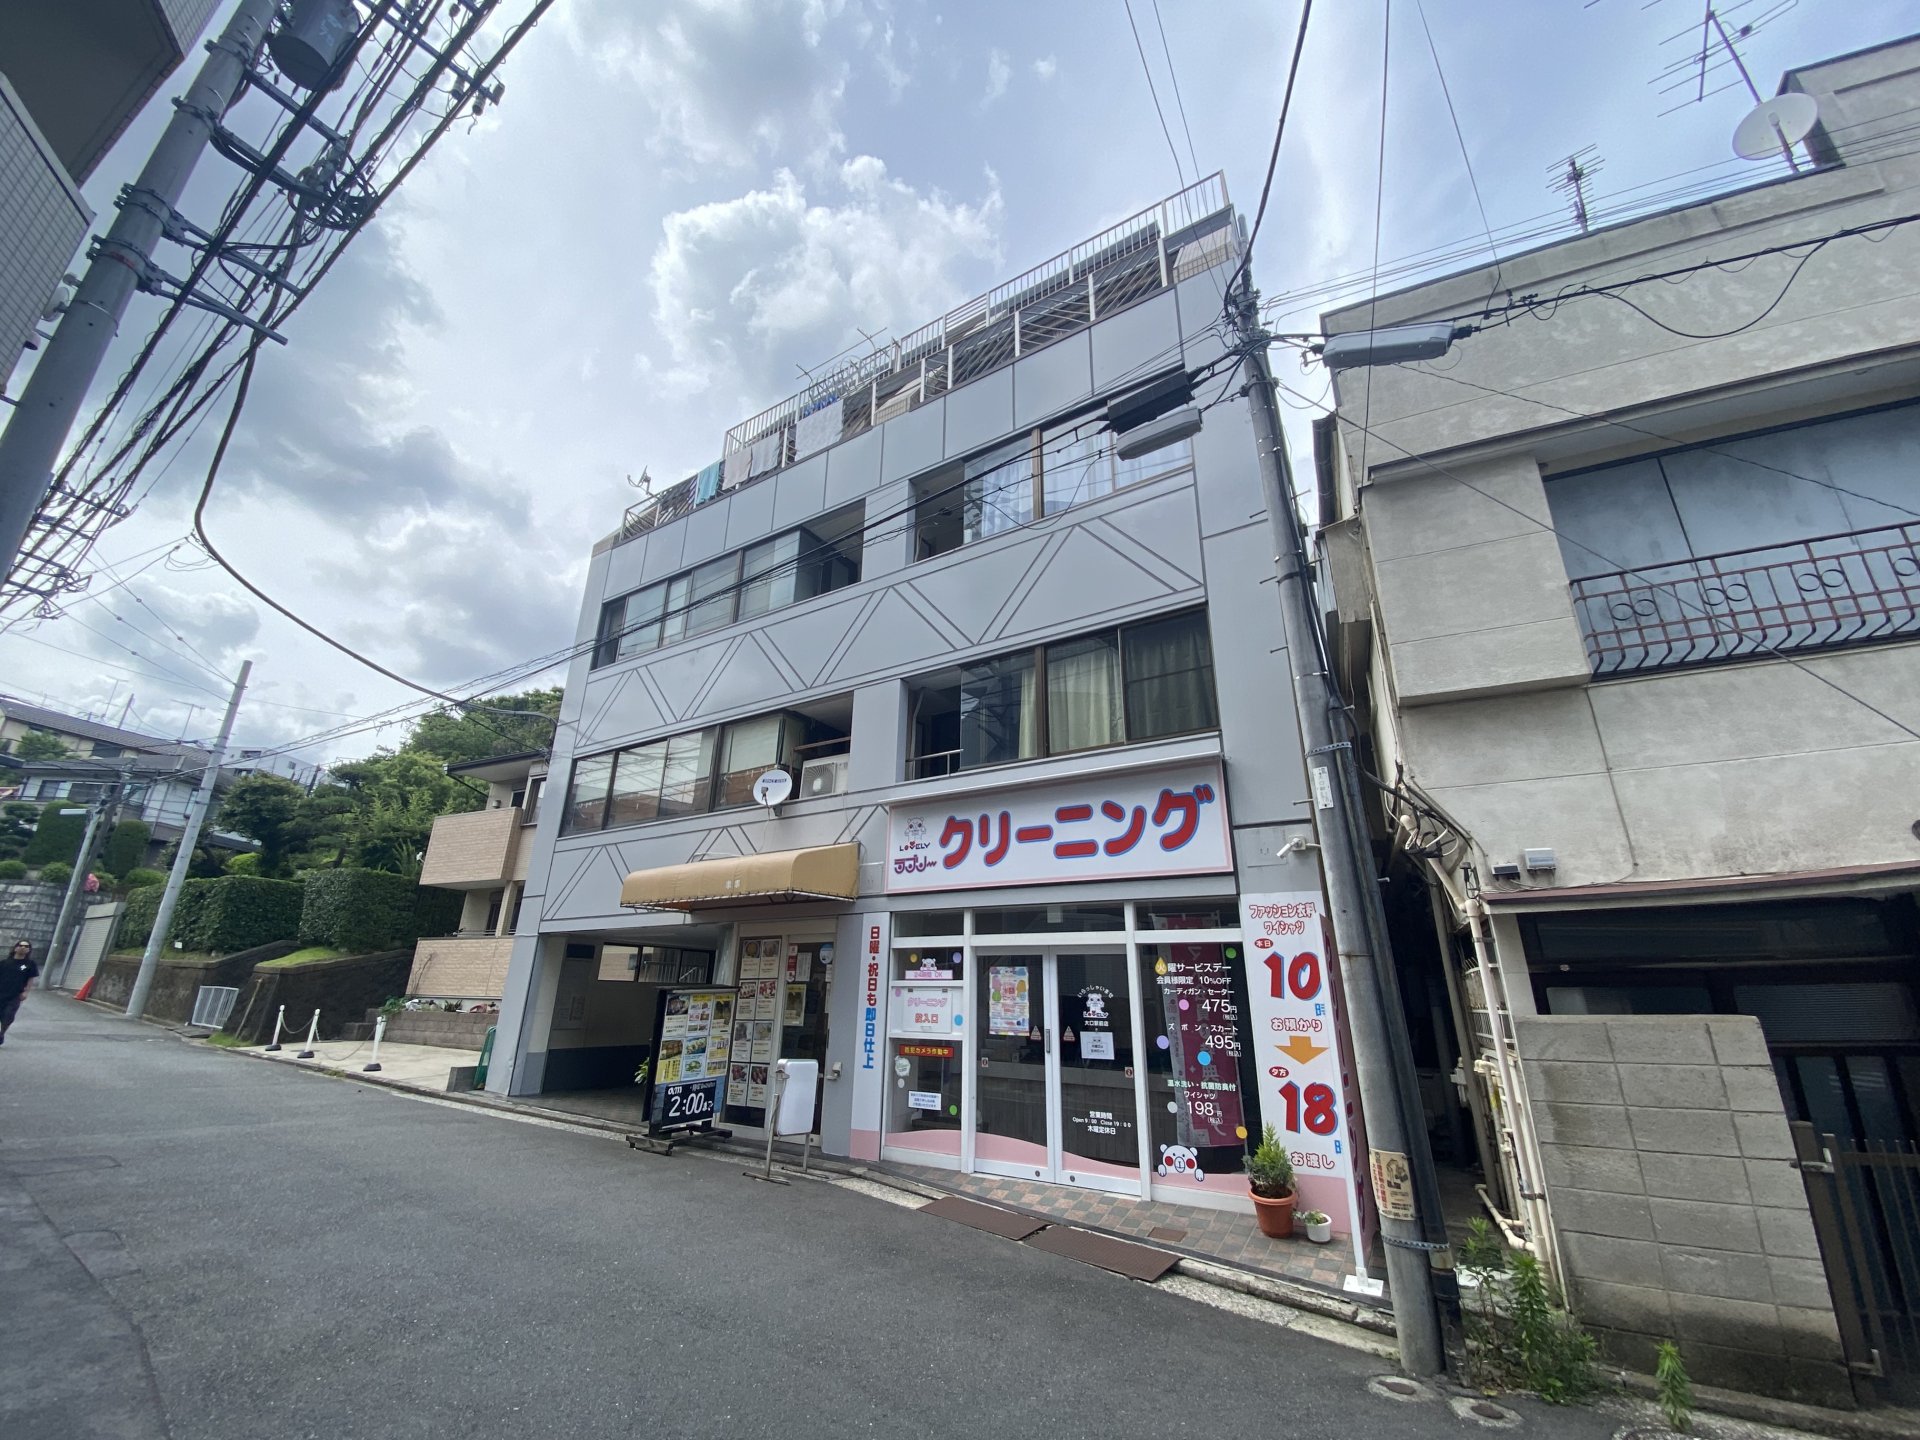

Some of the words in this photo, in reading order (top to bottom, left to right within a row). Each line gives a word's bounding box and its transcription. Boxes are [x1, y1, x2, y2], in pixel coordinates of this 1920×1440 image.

[939, 784, 1215, 869] クリーニング
[899, 841, 931, 852] LOVELY
[1249, 902, 1317, 919] ファッション衣料
[1263, 920, 1305, 935] ワイシャツ
[1256, 940, 1272, 948] 本日
[1156, 976, 1194, 985] 会員様限定
[1263, 950, 1322, 1001] 10
[1077, 984, 1114, 999] いらっしゃいませ
[1271, 1017, 1323, 1033] お預かり
[1271, 1067, 1287, 1077] 夕方
[1183, 1090, 1216, 1100] ワイシャツ
[1278, 1079, 1339, 1137] 18
[1290, 1151, 1335, 1169] お渡し
